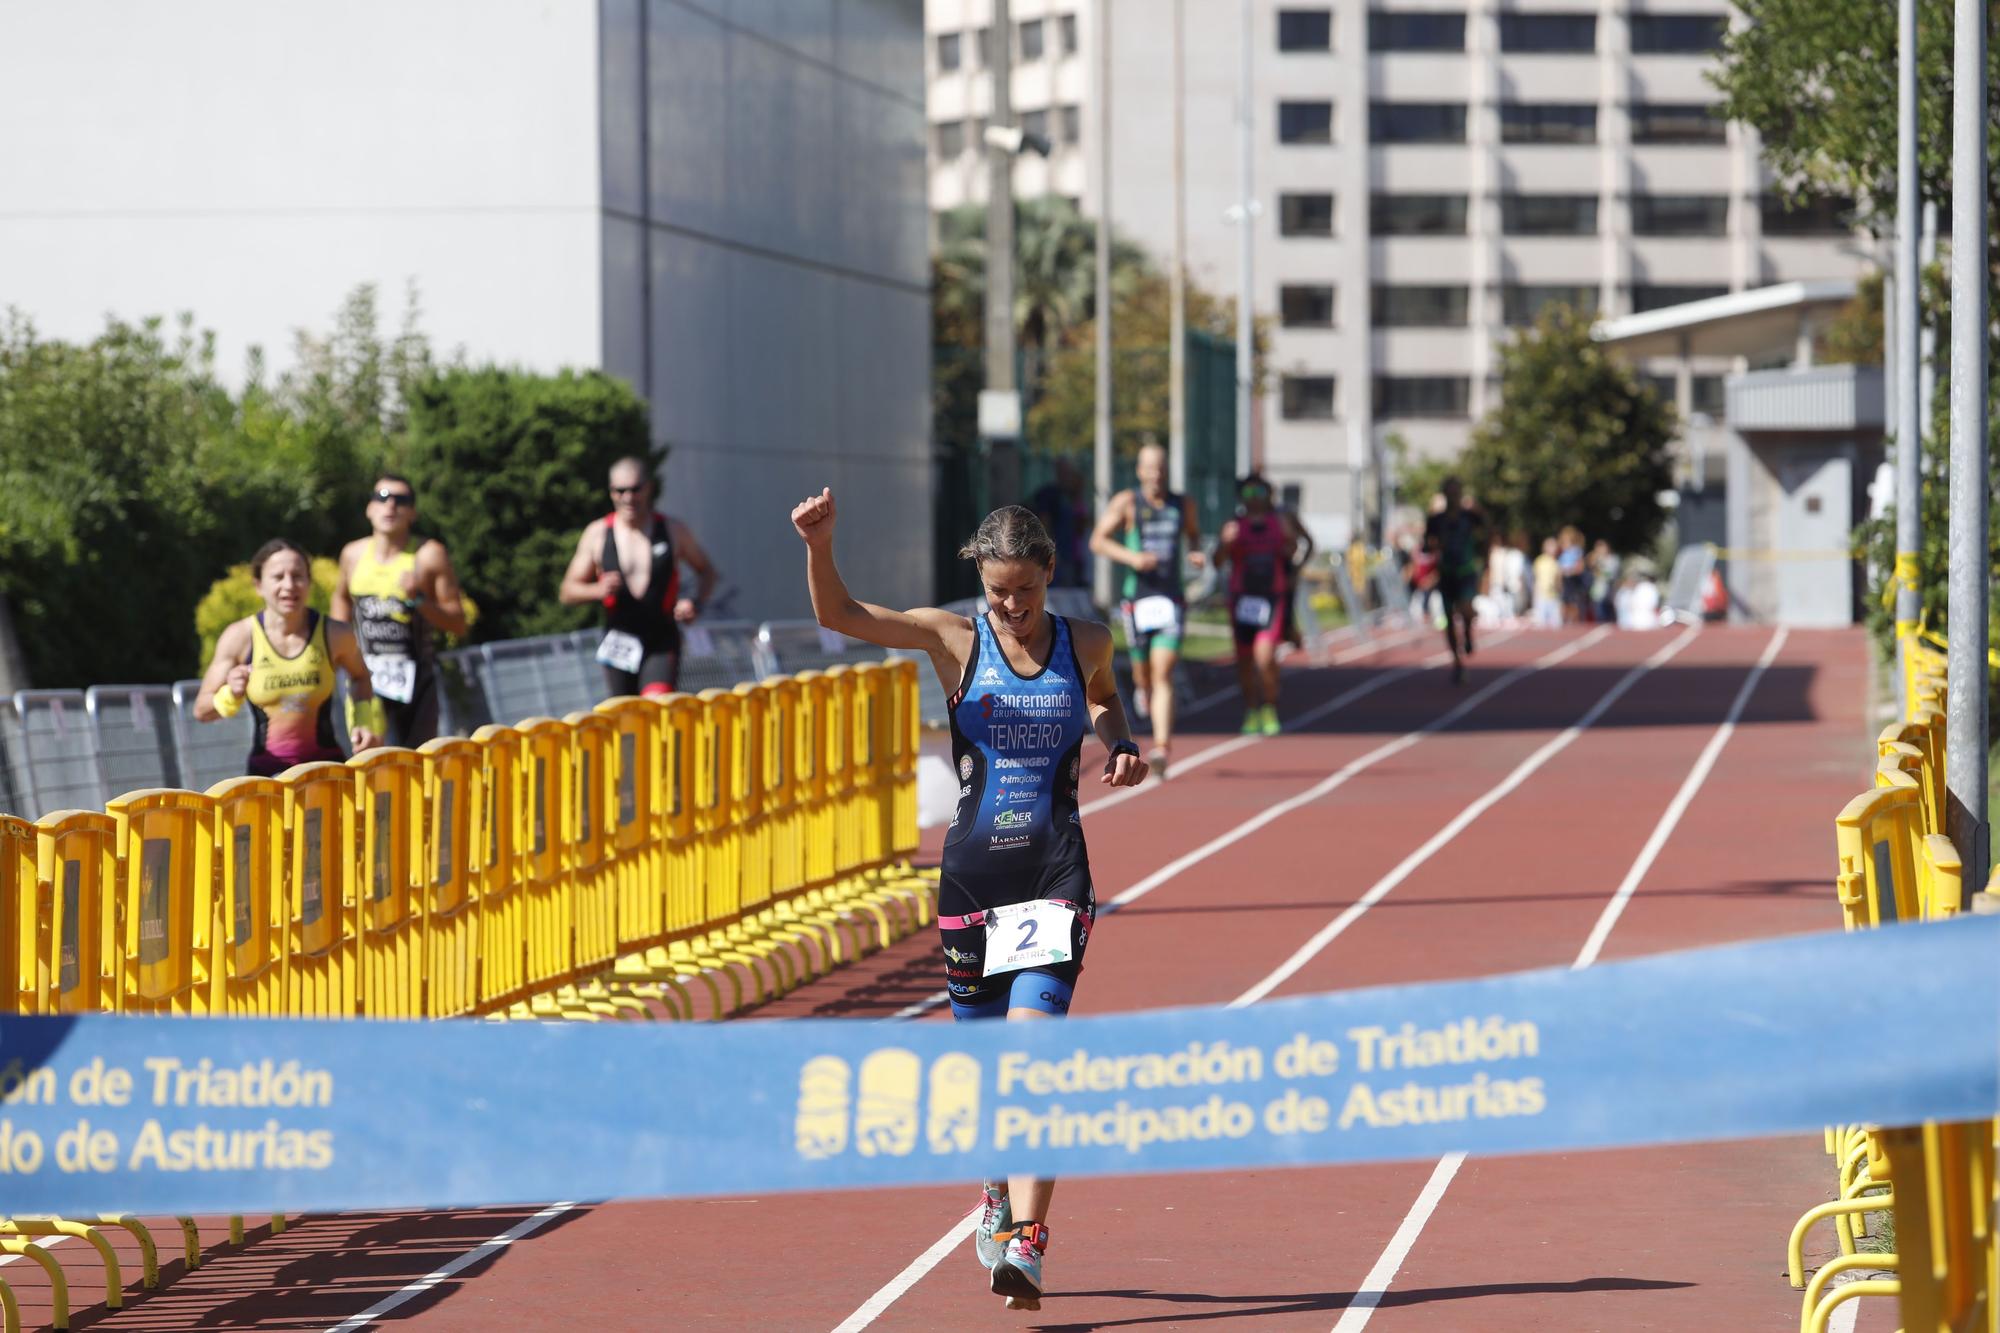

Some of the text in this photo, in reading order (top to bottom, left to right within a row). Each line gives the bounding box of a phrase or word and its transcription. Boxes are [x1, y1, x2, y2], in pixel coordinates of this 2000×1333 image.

[988, 723, 1063, 750] TENREIRO
[995, 757, 1050, 769] SONINGEO
[1009, 790, 1038, 800] Pefersa
[1016, 918, 1039, 952] 2
[1007, 949, 1047, 963] BEATRIZ
[997, 1014, 1539, 1096] Federación de Triatlón
[68, 1056, 133, 1106] de
[144, 1056, 333, 1107] Triatlón
[994, 1072, 1547, 1154] Principado de Asturias
[55, 1118, 119, 1173] de
[128, 1118, 334, 1172] Asturias
